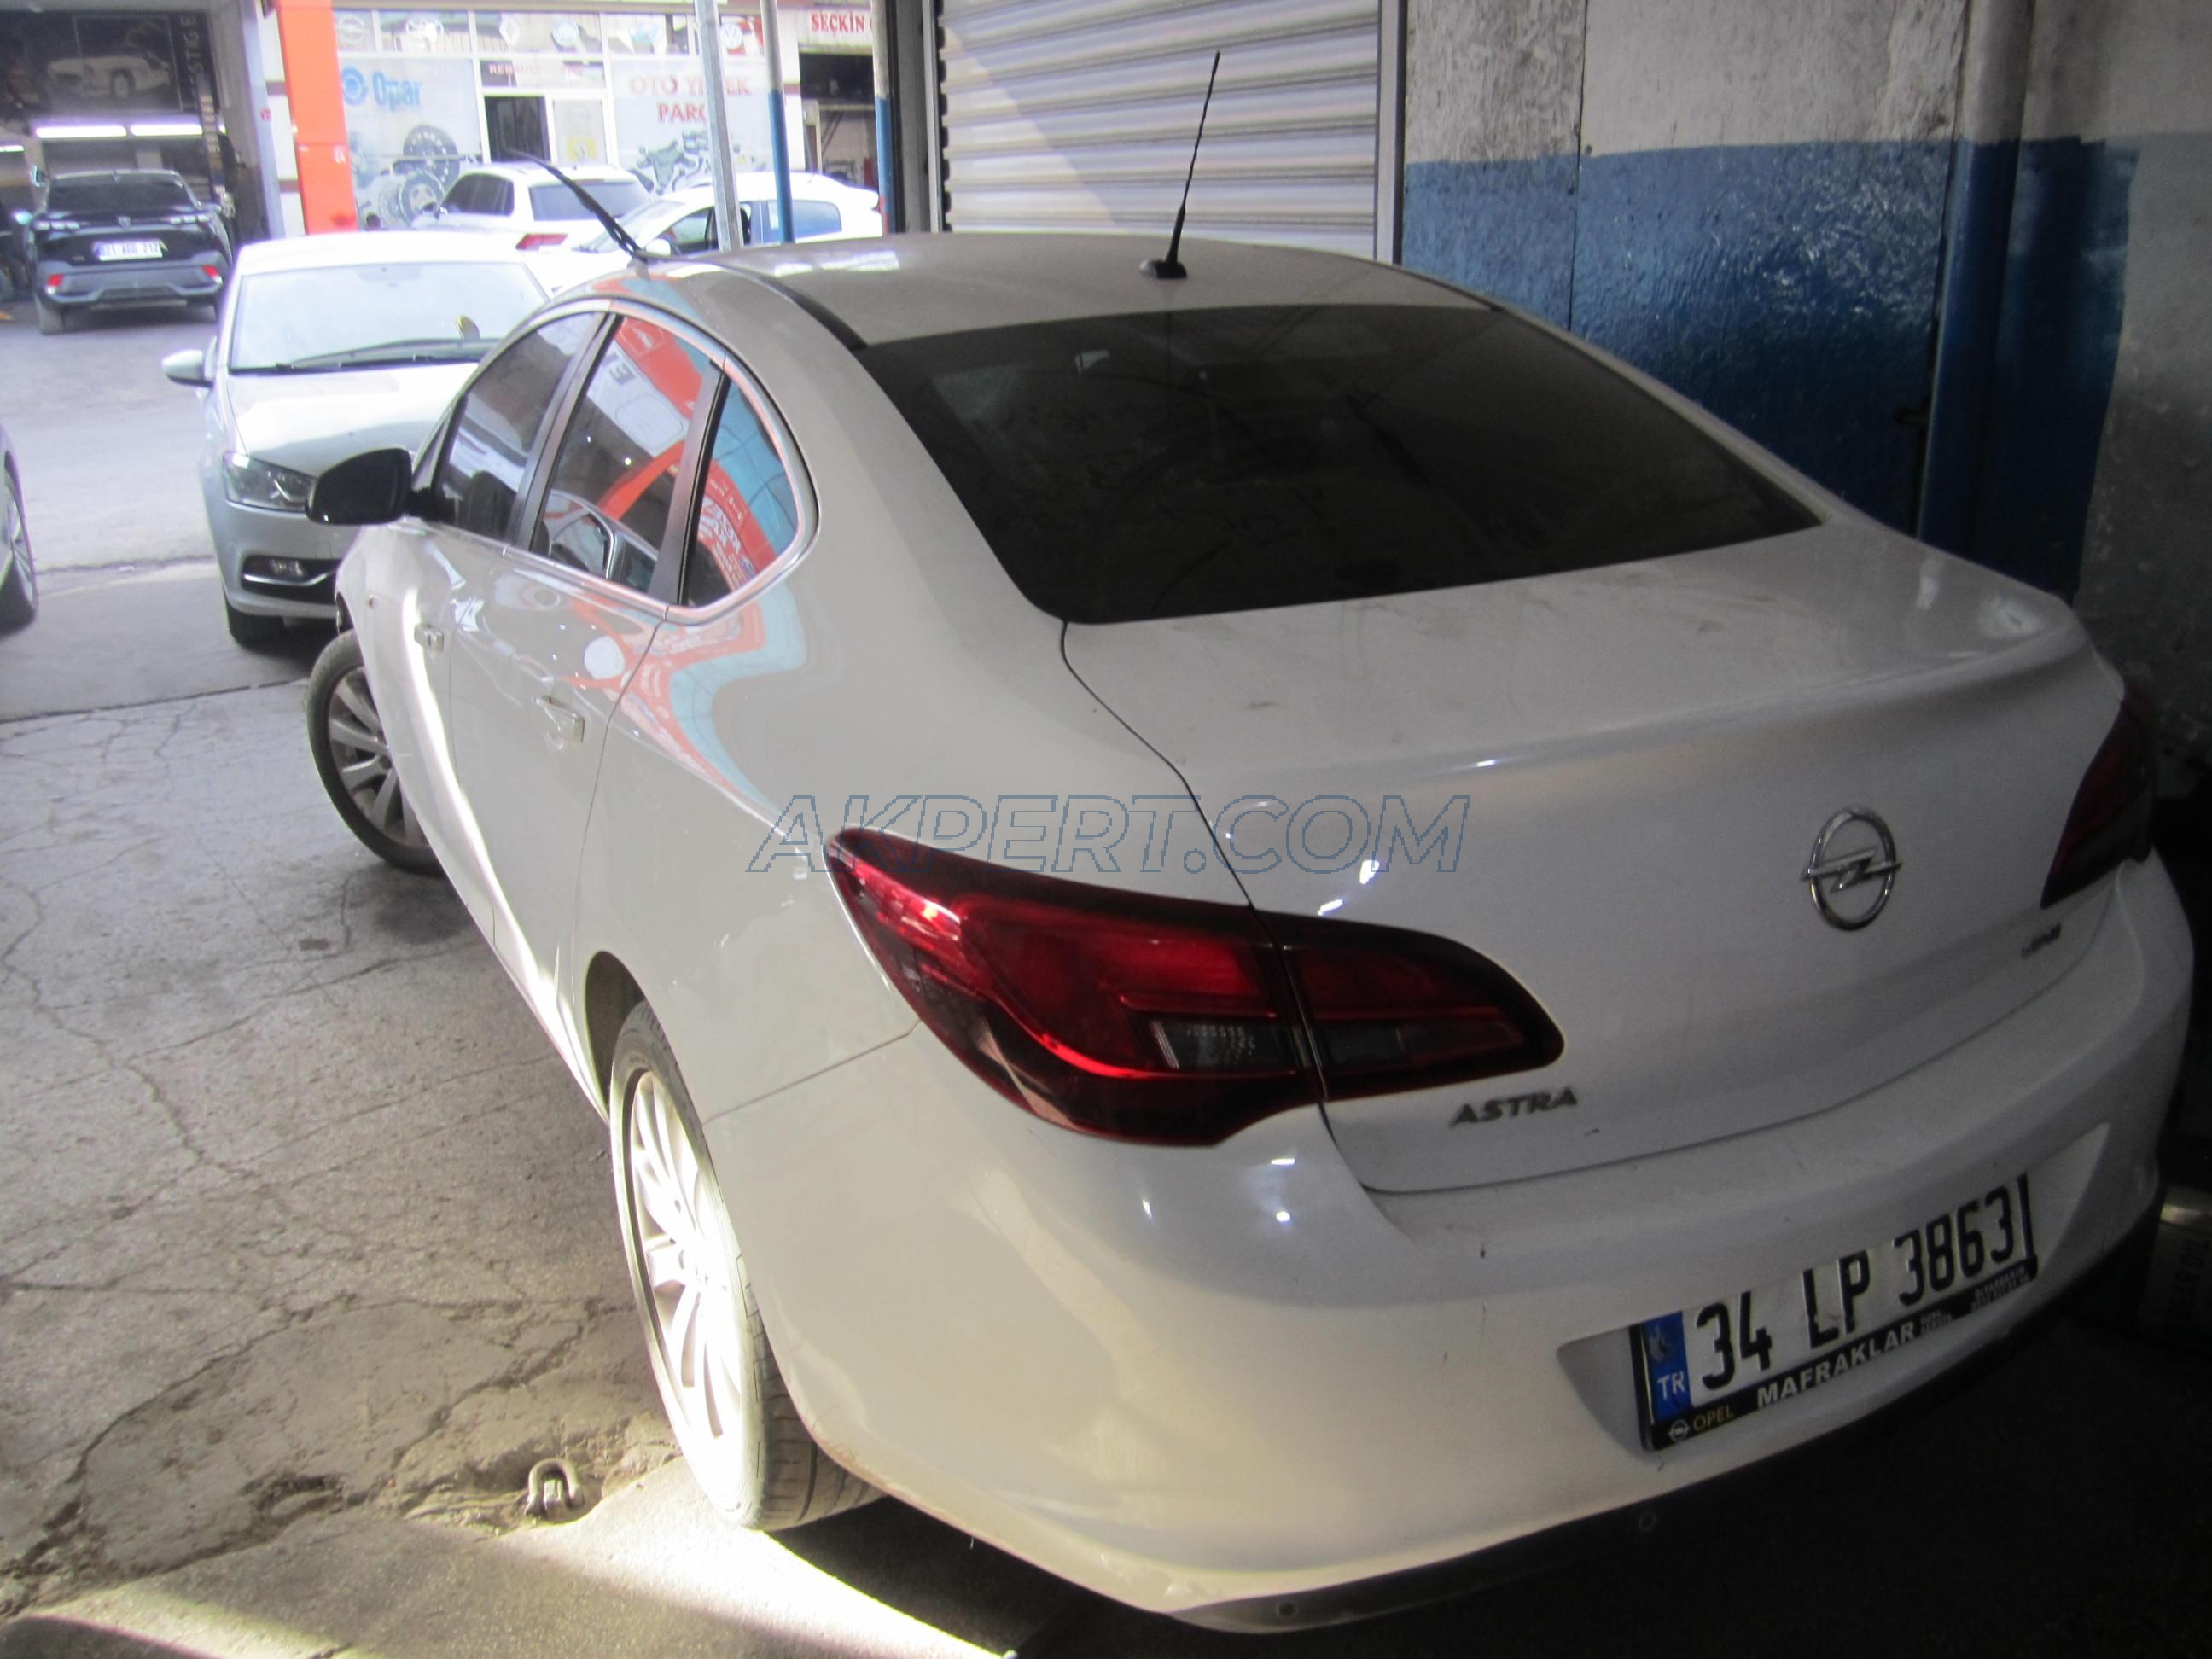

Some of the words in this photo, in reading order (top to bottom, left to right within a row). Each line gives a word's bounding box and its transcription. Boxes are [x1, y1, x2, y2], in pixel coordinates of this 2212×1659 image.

[372, 72, 422, 112] Opar
[629, 75, 679, 96] OTO
[685, 74, 752, 96] YEK
[657, 101, 707, 125] PAR
[1449, 1086, 1578, 1129] ASTRA
[1696, 1290, 1773, 1390] 34
[1802, 1249, 1871, 1349] LP
[1892, 1185, 2015, 1307] 3863
[1657, 1370, 1686, 1400] TR
[1692, 1405, 1735, 1431] OPEL
[1756, 1321, 1915, 1409] MAFRAKLAR
